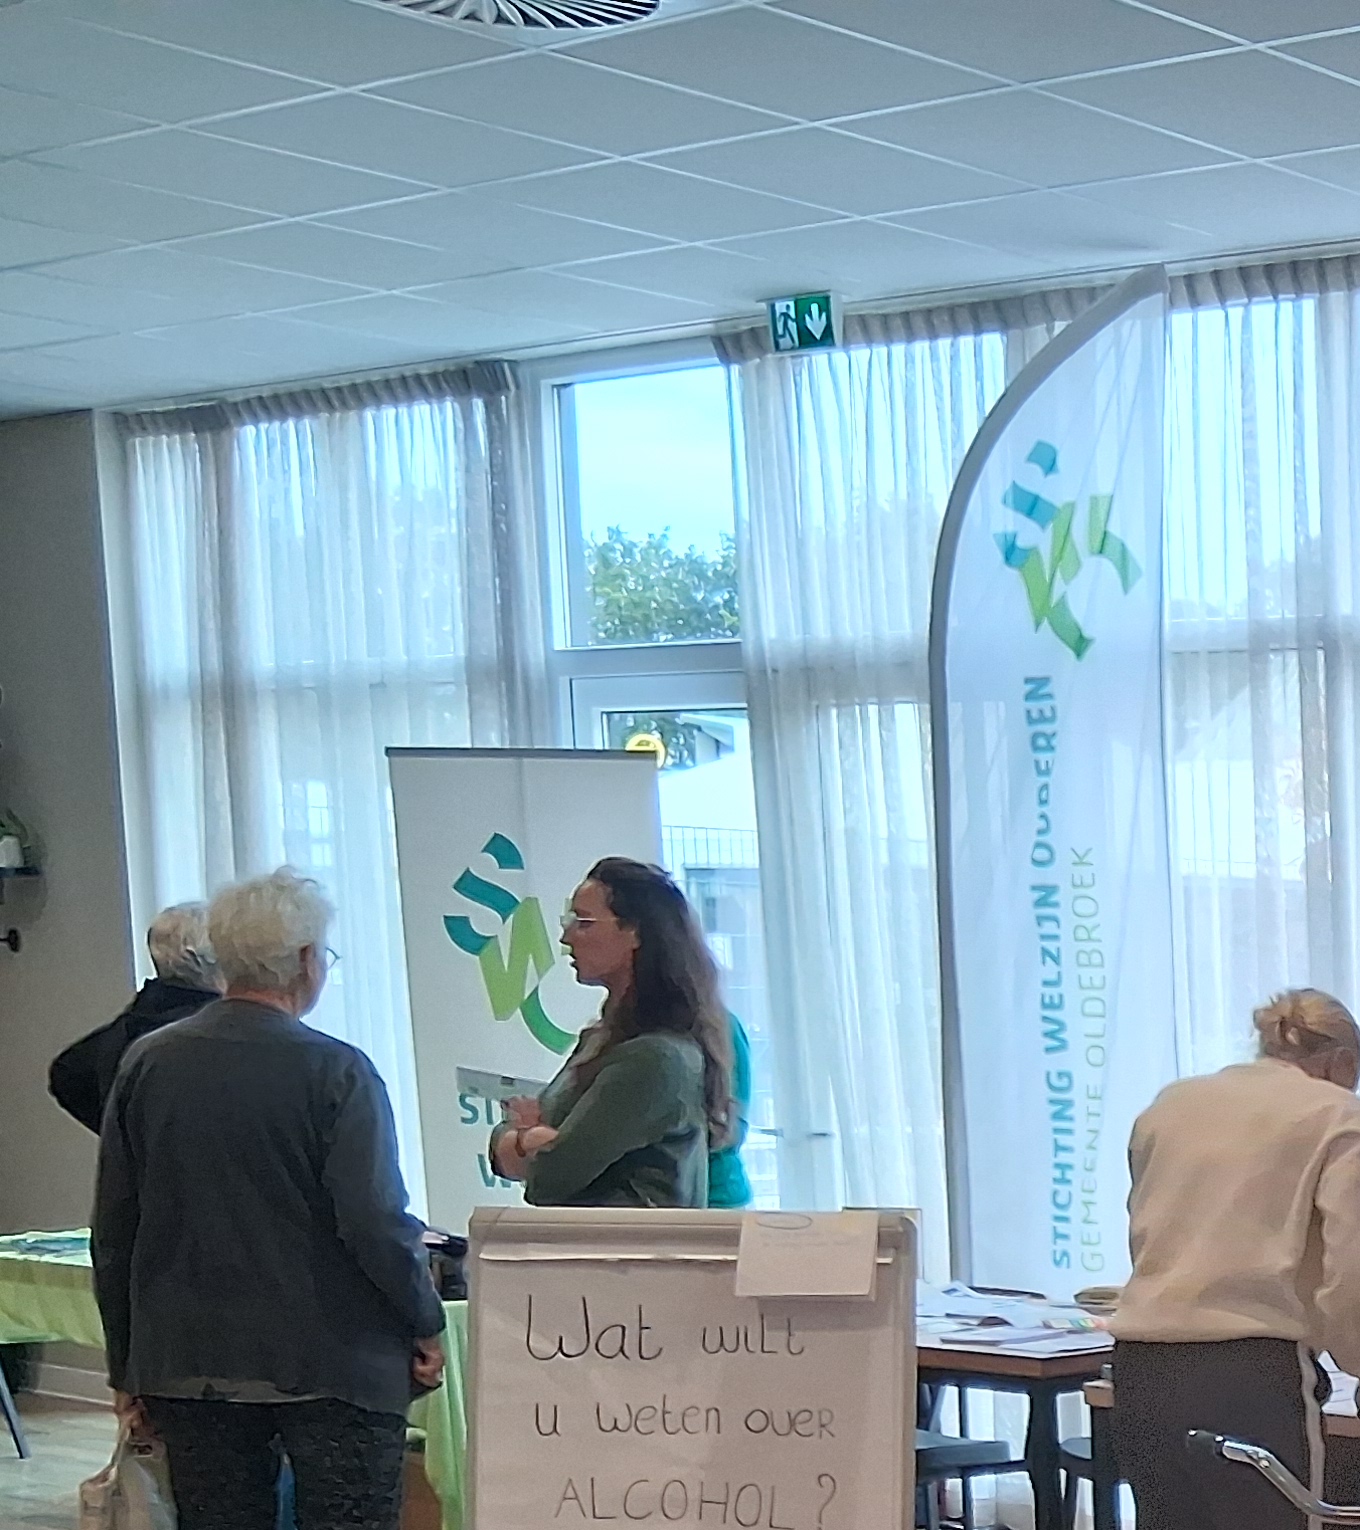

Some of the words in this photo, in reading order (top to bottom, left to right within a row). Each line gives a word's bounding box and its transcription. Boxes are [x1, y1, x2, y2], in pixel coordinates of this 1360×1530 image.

[1029, 884, 1069, 1055] WELZIJN
[1070, 847, 1107, 1068] OLDEBROEK
[1045, 1069, 1076, 1270] STICHTING
[1080, 1083, 1106, 1274] GEMEENTE
[526, 1294, 663, 1361] Wat
[535, 1402, 561, 1437] u
[595, 1394, 722, 1436] weten
